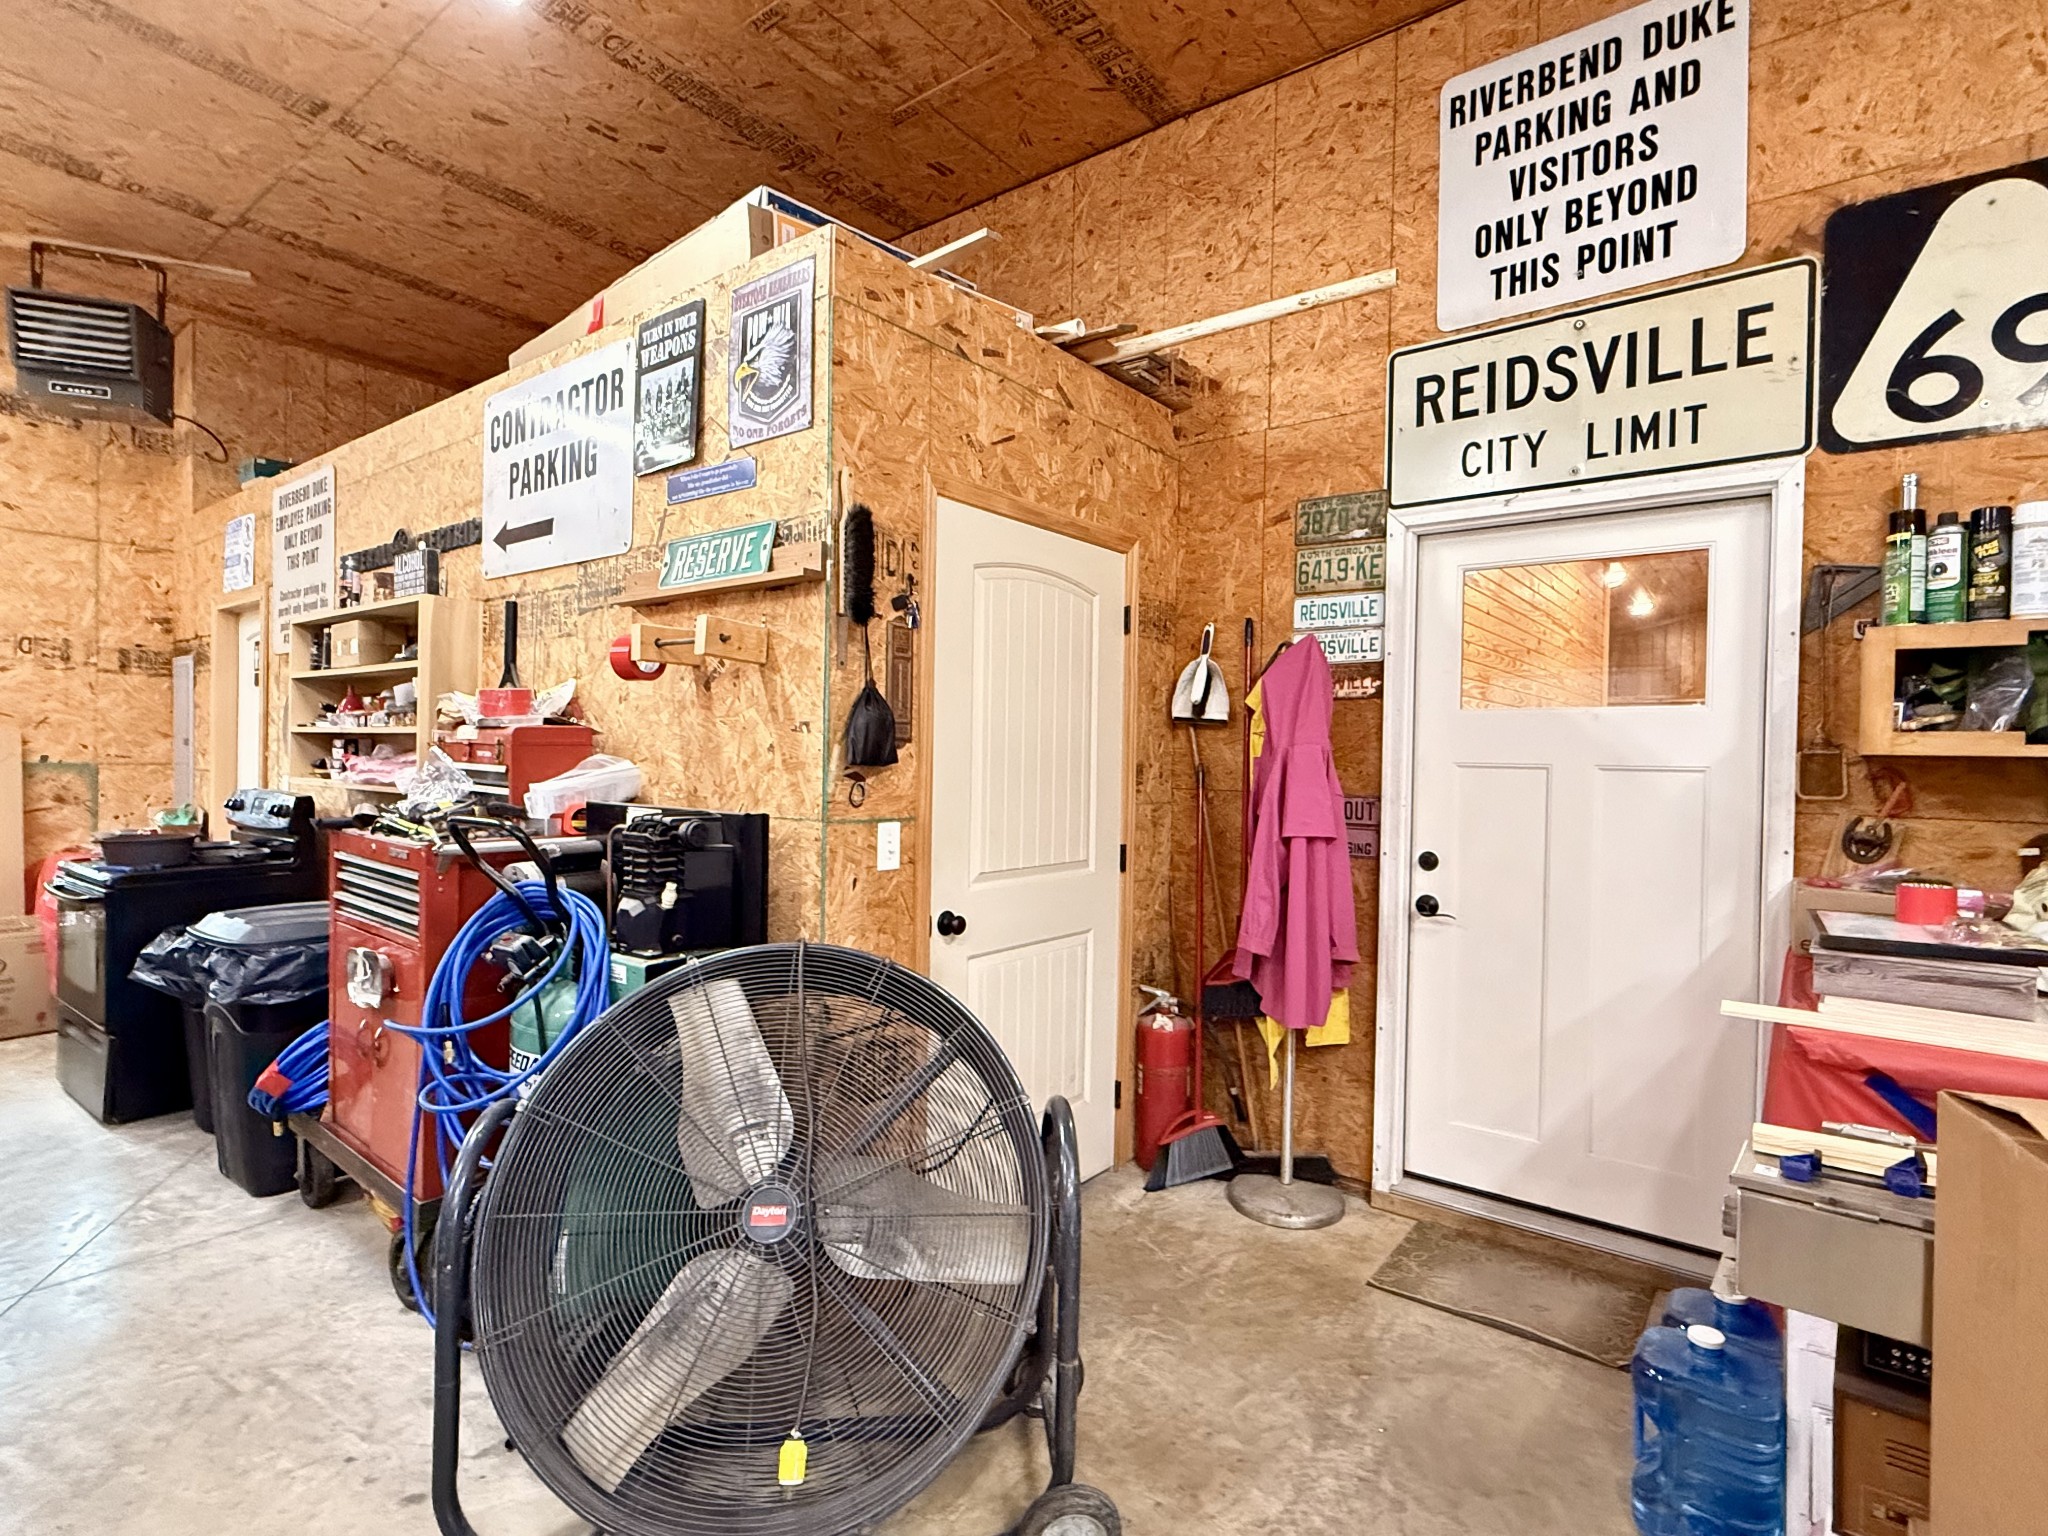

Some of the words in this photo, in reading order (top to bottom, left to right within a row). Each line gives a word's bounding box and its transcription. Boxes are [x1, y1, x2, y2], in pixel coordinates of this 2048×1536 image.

[1450, 36, 1623, 129] RIVERBEND
[1643, 0, 1735, 60] DUKE
[1475, 89, 1611, 167] PARKING
[1629, 59, 1701, 116] AND
[1509, 124, 1659, 202] VISITORS
[1475, 206, 1549, 259] ONLY
[1565, 164, 1697, 235] BEYOND
[1490, 252, 1559, 301] THIS
[1577, 220, 1678, 281] POINT
[642, 324, 663, 347] TURN
[664, 319, 674, 337] IN
[675, 311, 697, 333] YOUR
[641, 329, 697, 369] WEAPONS
[1415, 302, 1775, 428] REIDSVILLE
[490, 367, 624, 454] CONTRACTOR
[766, 404, 807, 437] FORGETS
[1461, 429, 1548, 478] CITY
[1586, 403, 1708, 461] LIMIT
[509, 436, 598, 500] PARKING
[275, 508, 304, 532] EMPLOYEE
[306, 497, 332, 523] PARKING
[283, 532, 298, 551] ONLY
[300, 523, 322, 546] BEYOND
[1300, 548, 1331, 560] NORTH
[1334, 544, 1383, 557] CAROLINA
[287, 552, 300, 571] THIS
[302, 546, 319, 568] POINT
[394, 548, 425, 574] ALCOHOL
[670, 531, 758, 584] RESERVE
[1301, 599, 1379, 622] REIDSVILLE
[1318, 636, 1379, 655] DSVILLE
[1344, 801, 1376, 821] OUT
[752, 1205, 787, 1218] Dayton
